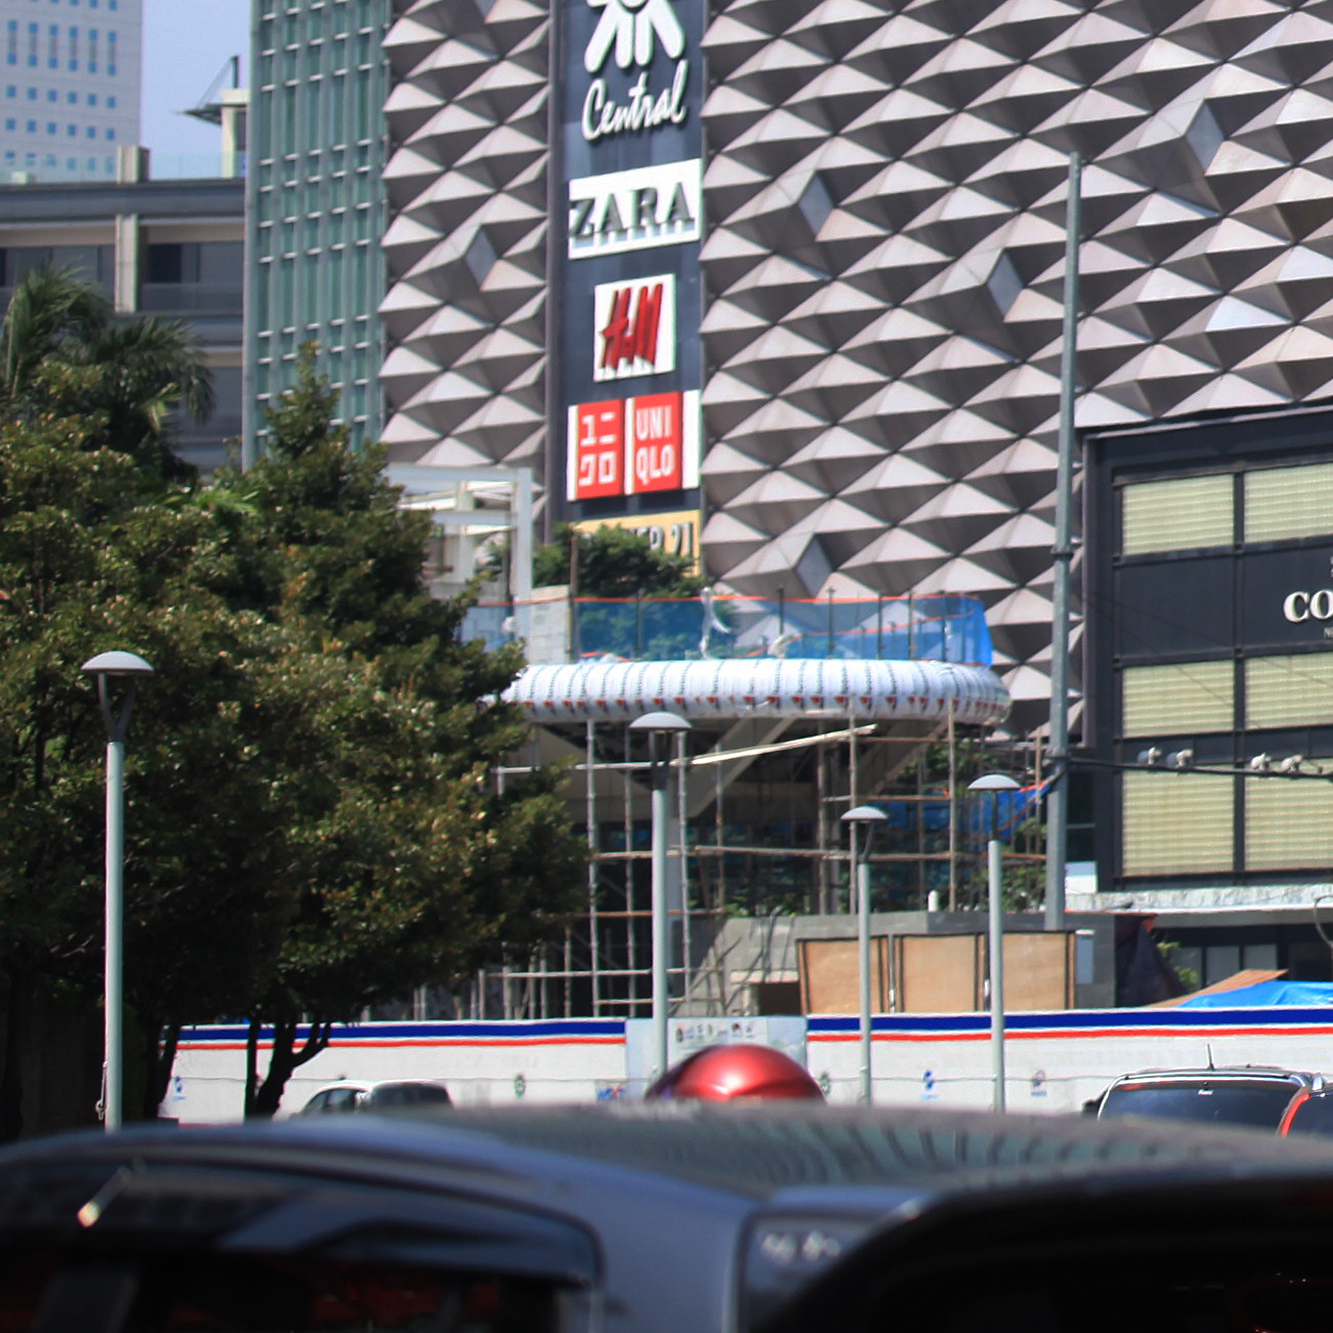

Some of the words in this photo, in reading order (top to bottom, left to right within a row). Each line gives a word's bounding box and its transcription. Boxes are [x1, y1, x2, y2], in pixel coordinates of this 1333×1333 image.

[581, 59, 689, 141] Central
[569, 181, 695, 239] ZARA
[635, 405, 673, 441] UNI
[635, 444, 676, 485] QLO
